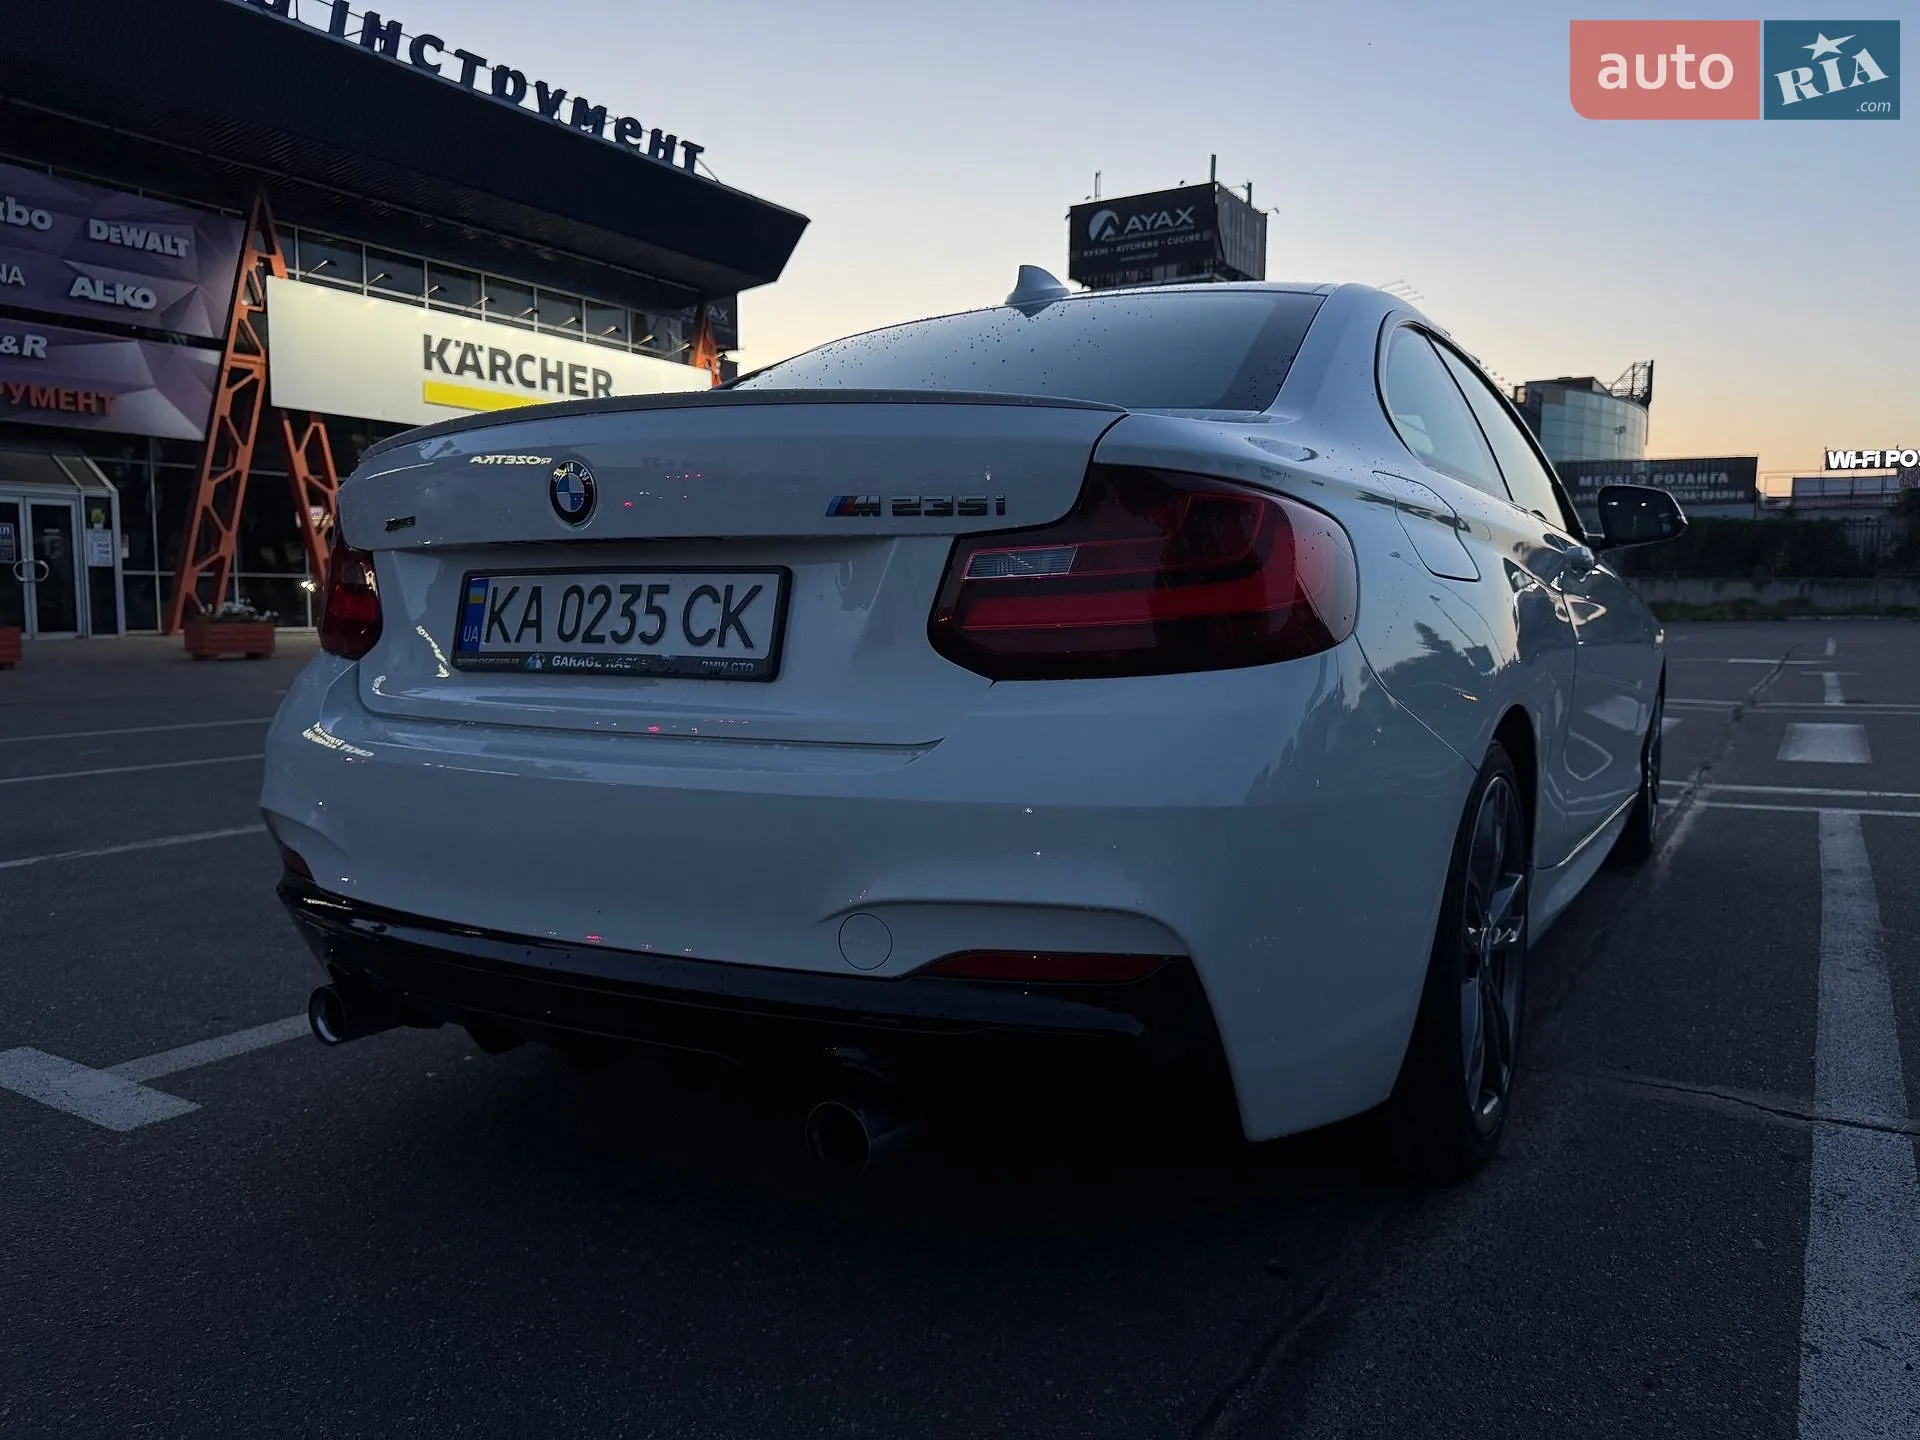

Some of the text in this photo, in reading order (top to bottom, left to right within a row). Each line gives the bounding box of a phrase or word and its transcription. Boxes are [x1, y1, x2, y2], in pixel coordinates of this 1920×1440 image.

[0, 196, 53, 231] bo
[1123, 206, 1195, 234] AYAX
[69, 276, 158, 310] AL-KO
[423, 334, 613, 398] KÄRCHER
[484, 584, 763, 649] KA 0235 CK
[463, 625, 479, 643] UA
